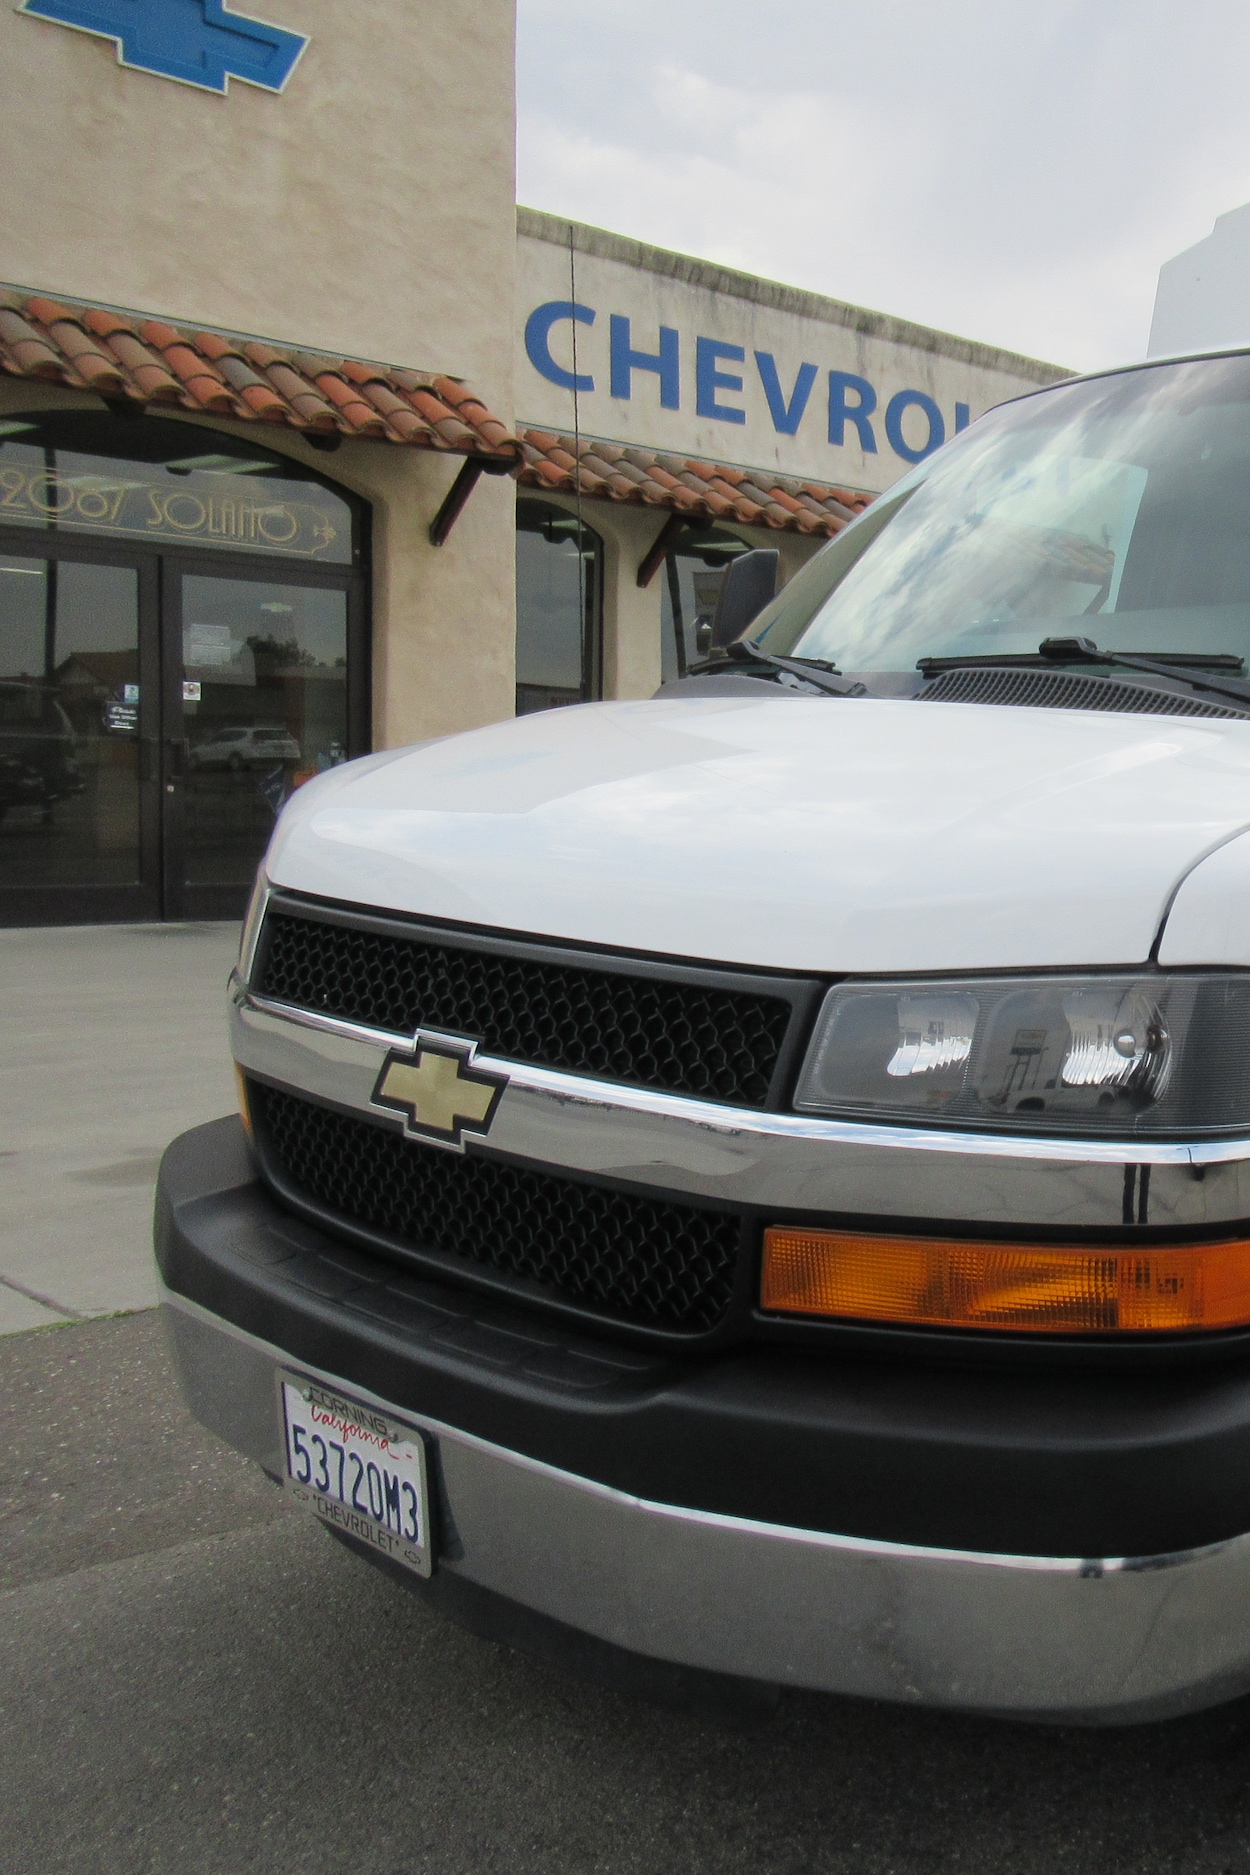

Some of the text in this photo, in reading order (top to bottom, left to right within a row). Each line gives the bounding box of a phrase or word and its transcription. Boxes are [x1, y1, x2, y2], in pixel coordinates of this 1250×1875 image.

[147, 487, 298, 542] SOLANO
[309, 1387, 388, 1435] CORNING
[310, 1404, 399, 1459] California
[292, 1423, 419, 1544] 53720M3
[316, 1496, 394, 1553] CHEVROLET
